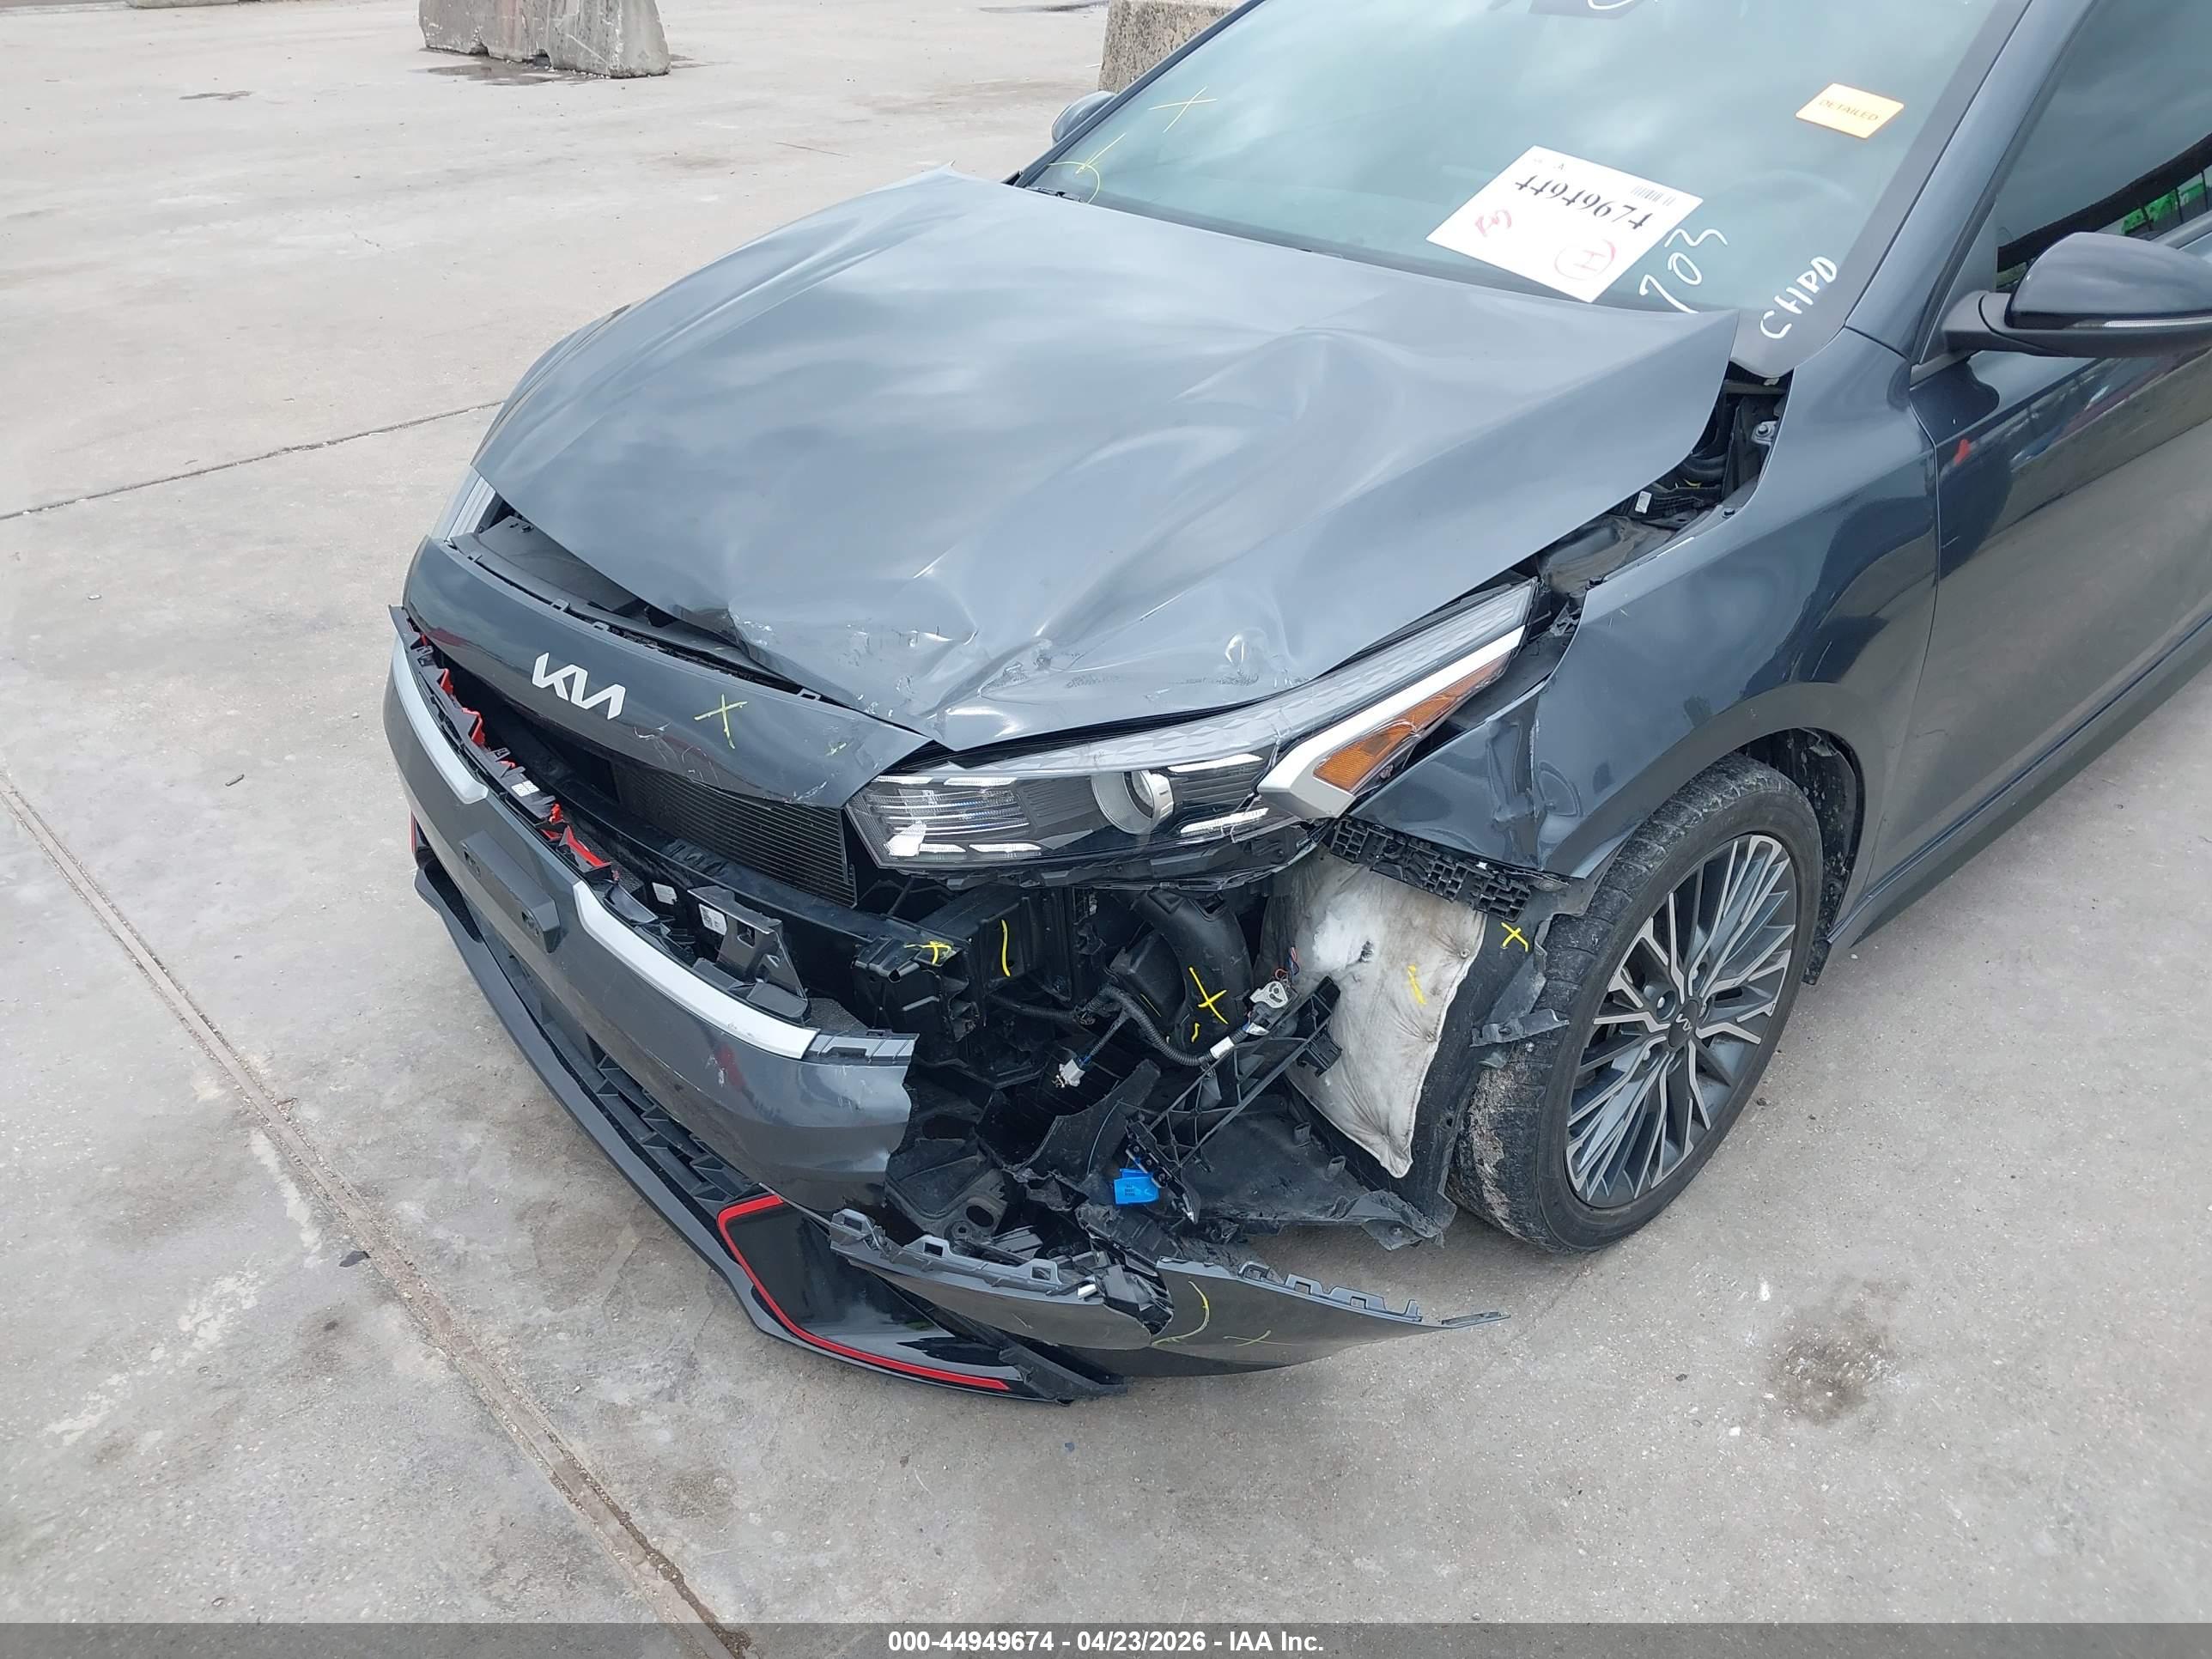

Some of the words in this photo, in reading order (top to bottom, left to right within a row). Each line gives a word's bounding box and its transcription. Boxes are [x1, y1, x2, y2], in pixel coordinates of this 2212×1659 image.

[1819, 99, 1880, 121] DETAILED
[1515, 174, 1654, 229] 44949674
[1638, 228, 1729, 314] 703
[1759, 256, 1838, 339] CHPD
[531, 652, 627, 720] KIA
